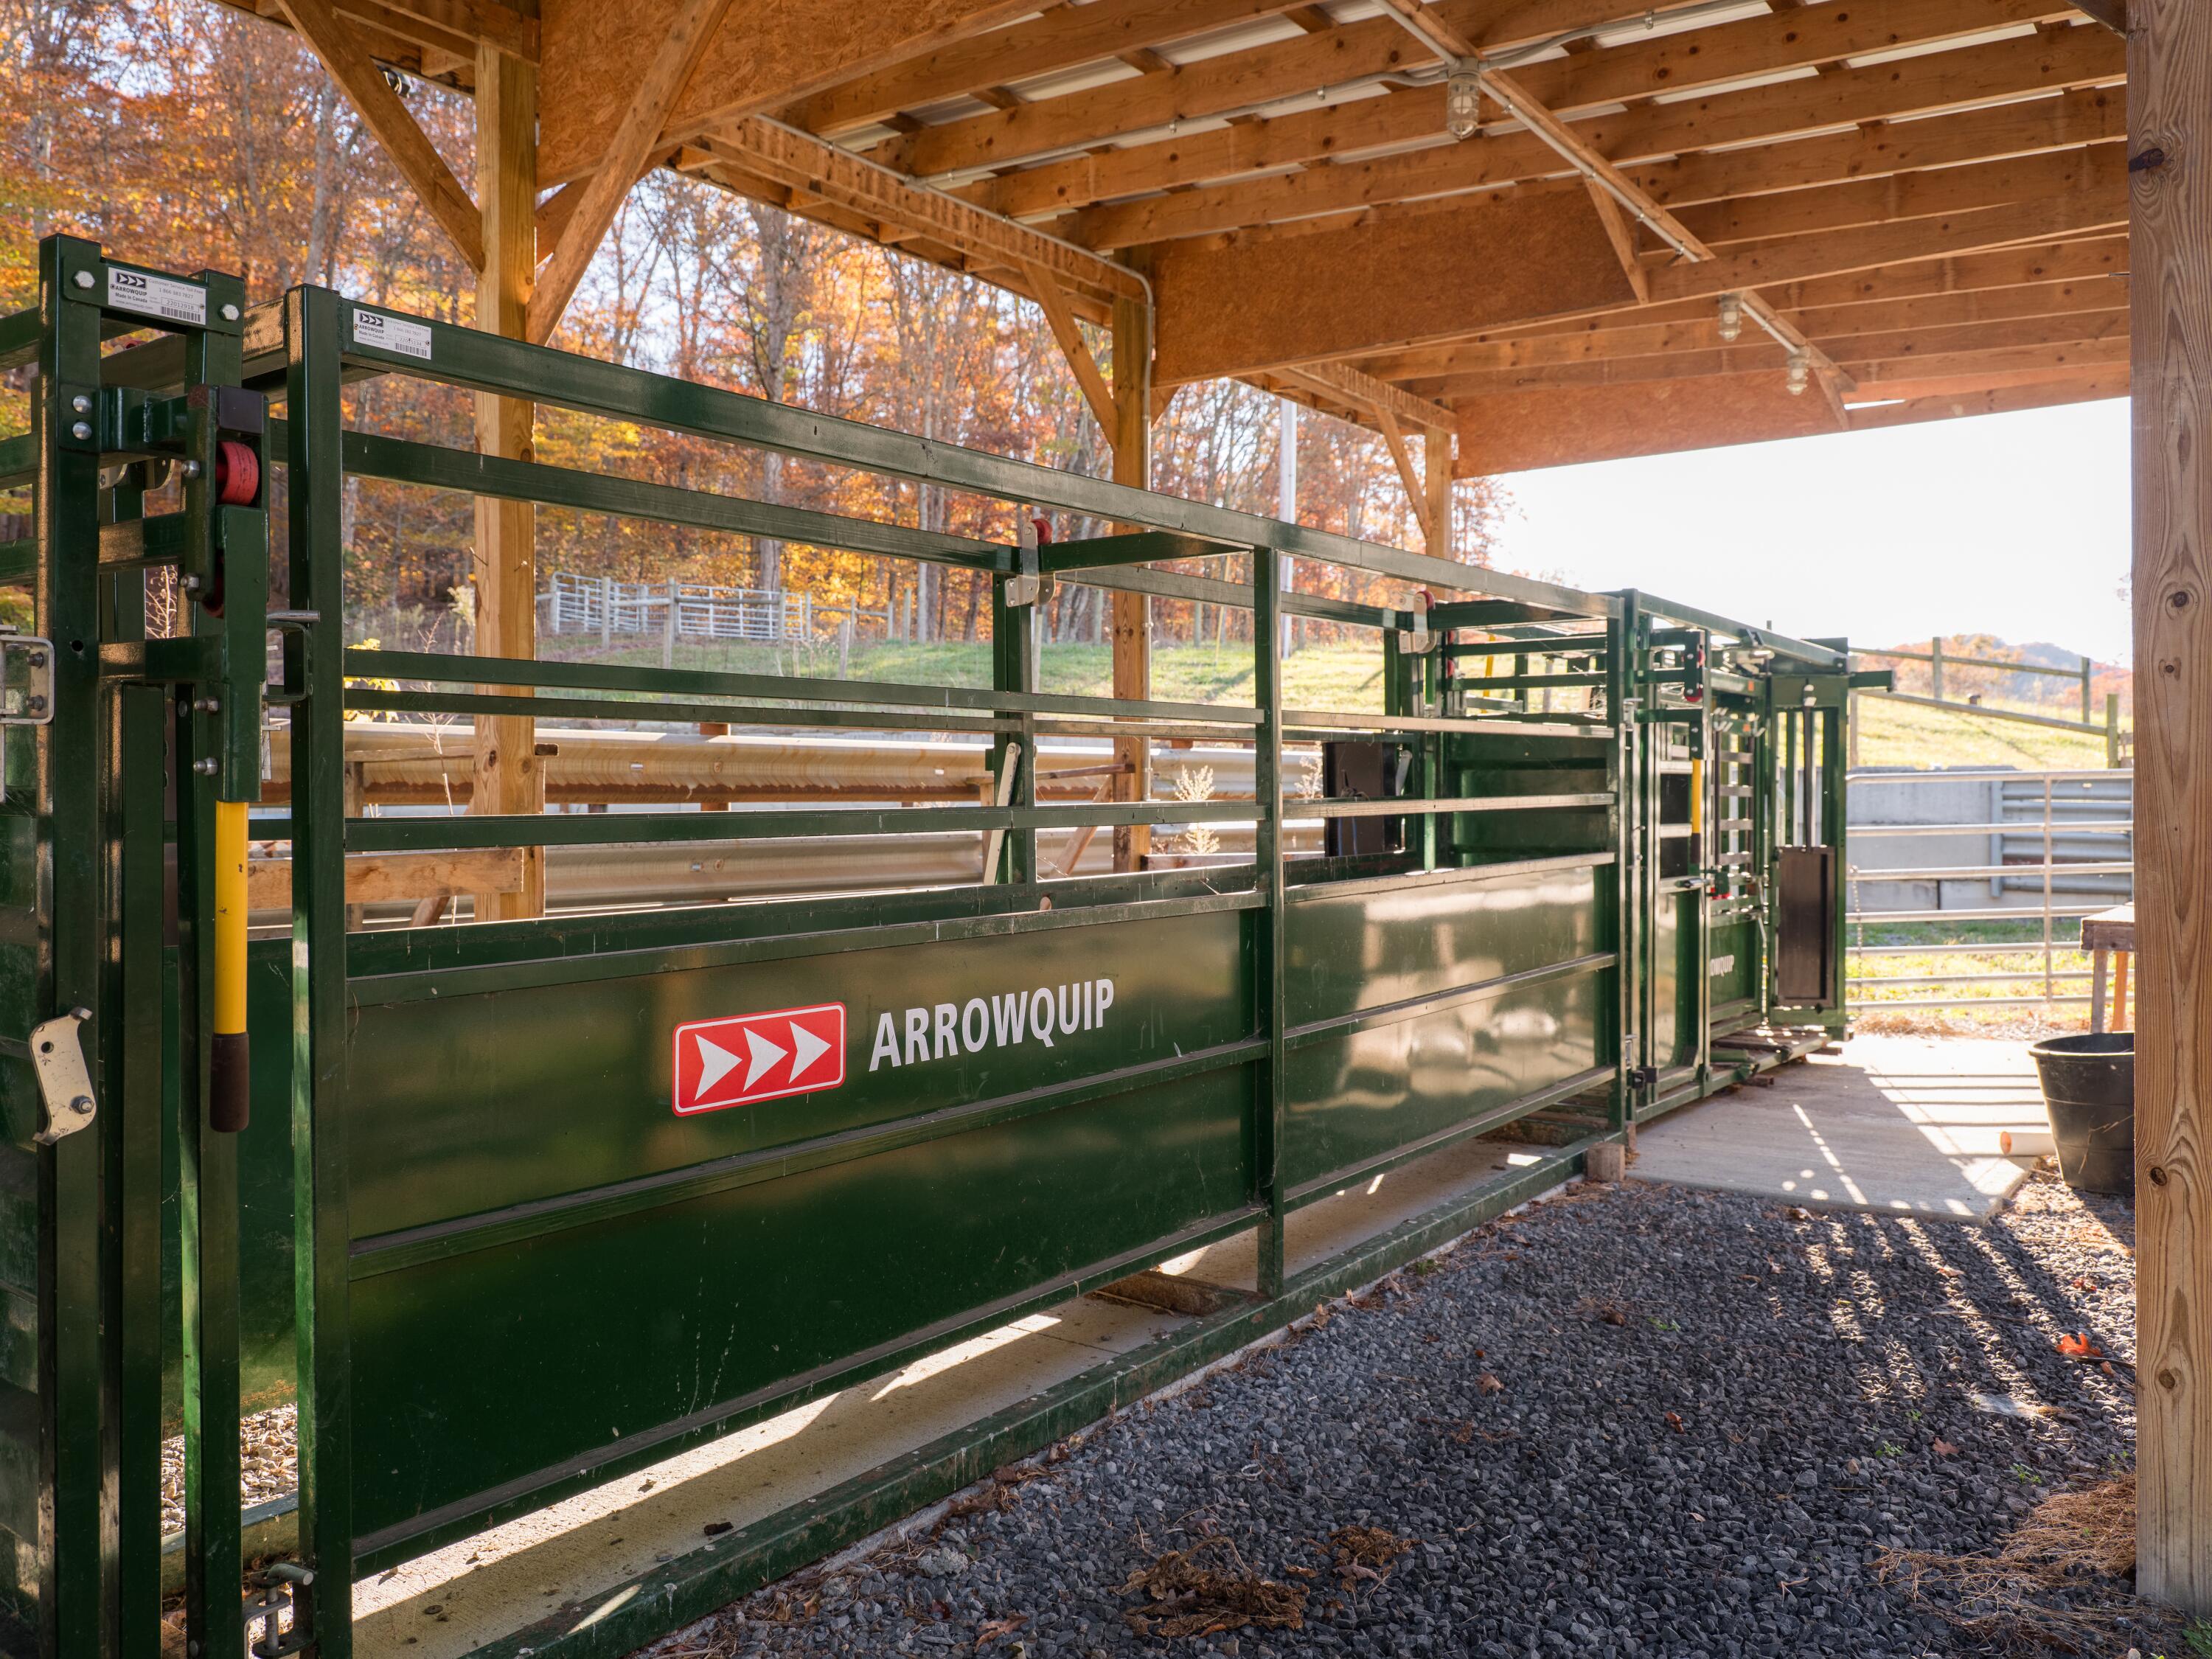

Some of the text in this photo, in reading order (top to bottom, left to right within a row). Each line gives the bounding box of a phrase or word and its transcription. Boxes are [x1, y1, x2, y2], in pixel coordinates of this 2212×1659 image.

[116, 286, 147, 296] ARROWQUIP
[359, 324, 384, 333] ARROWQUIP
[869, 978, 1114, 1072] ARROWQUIP
